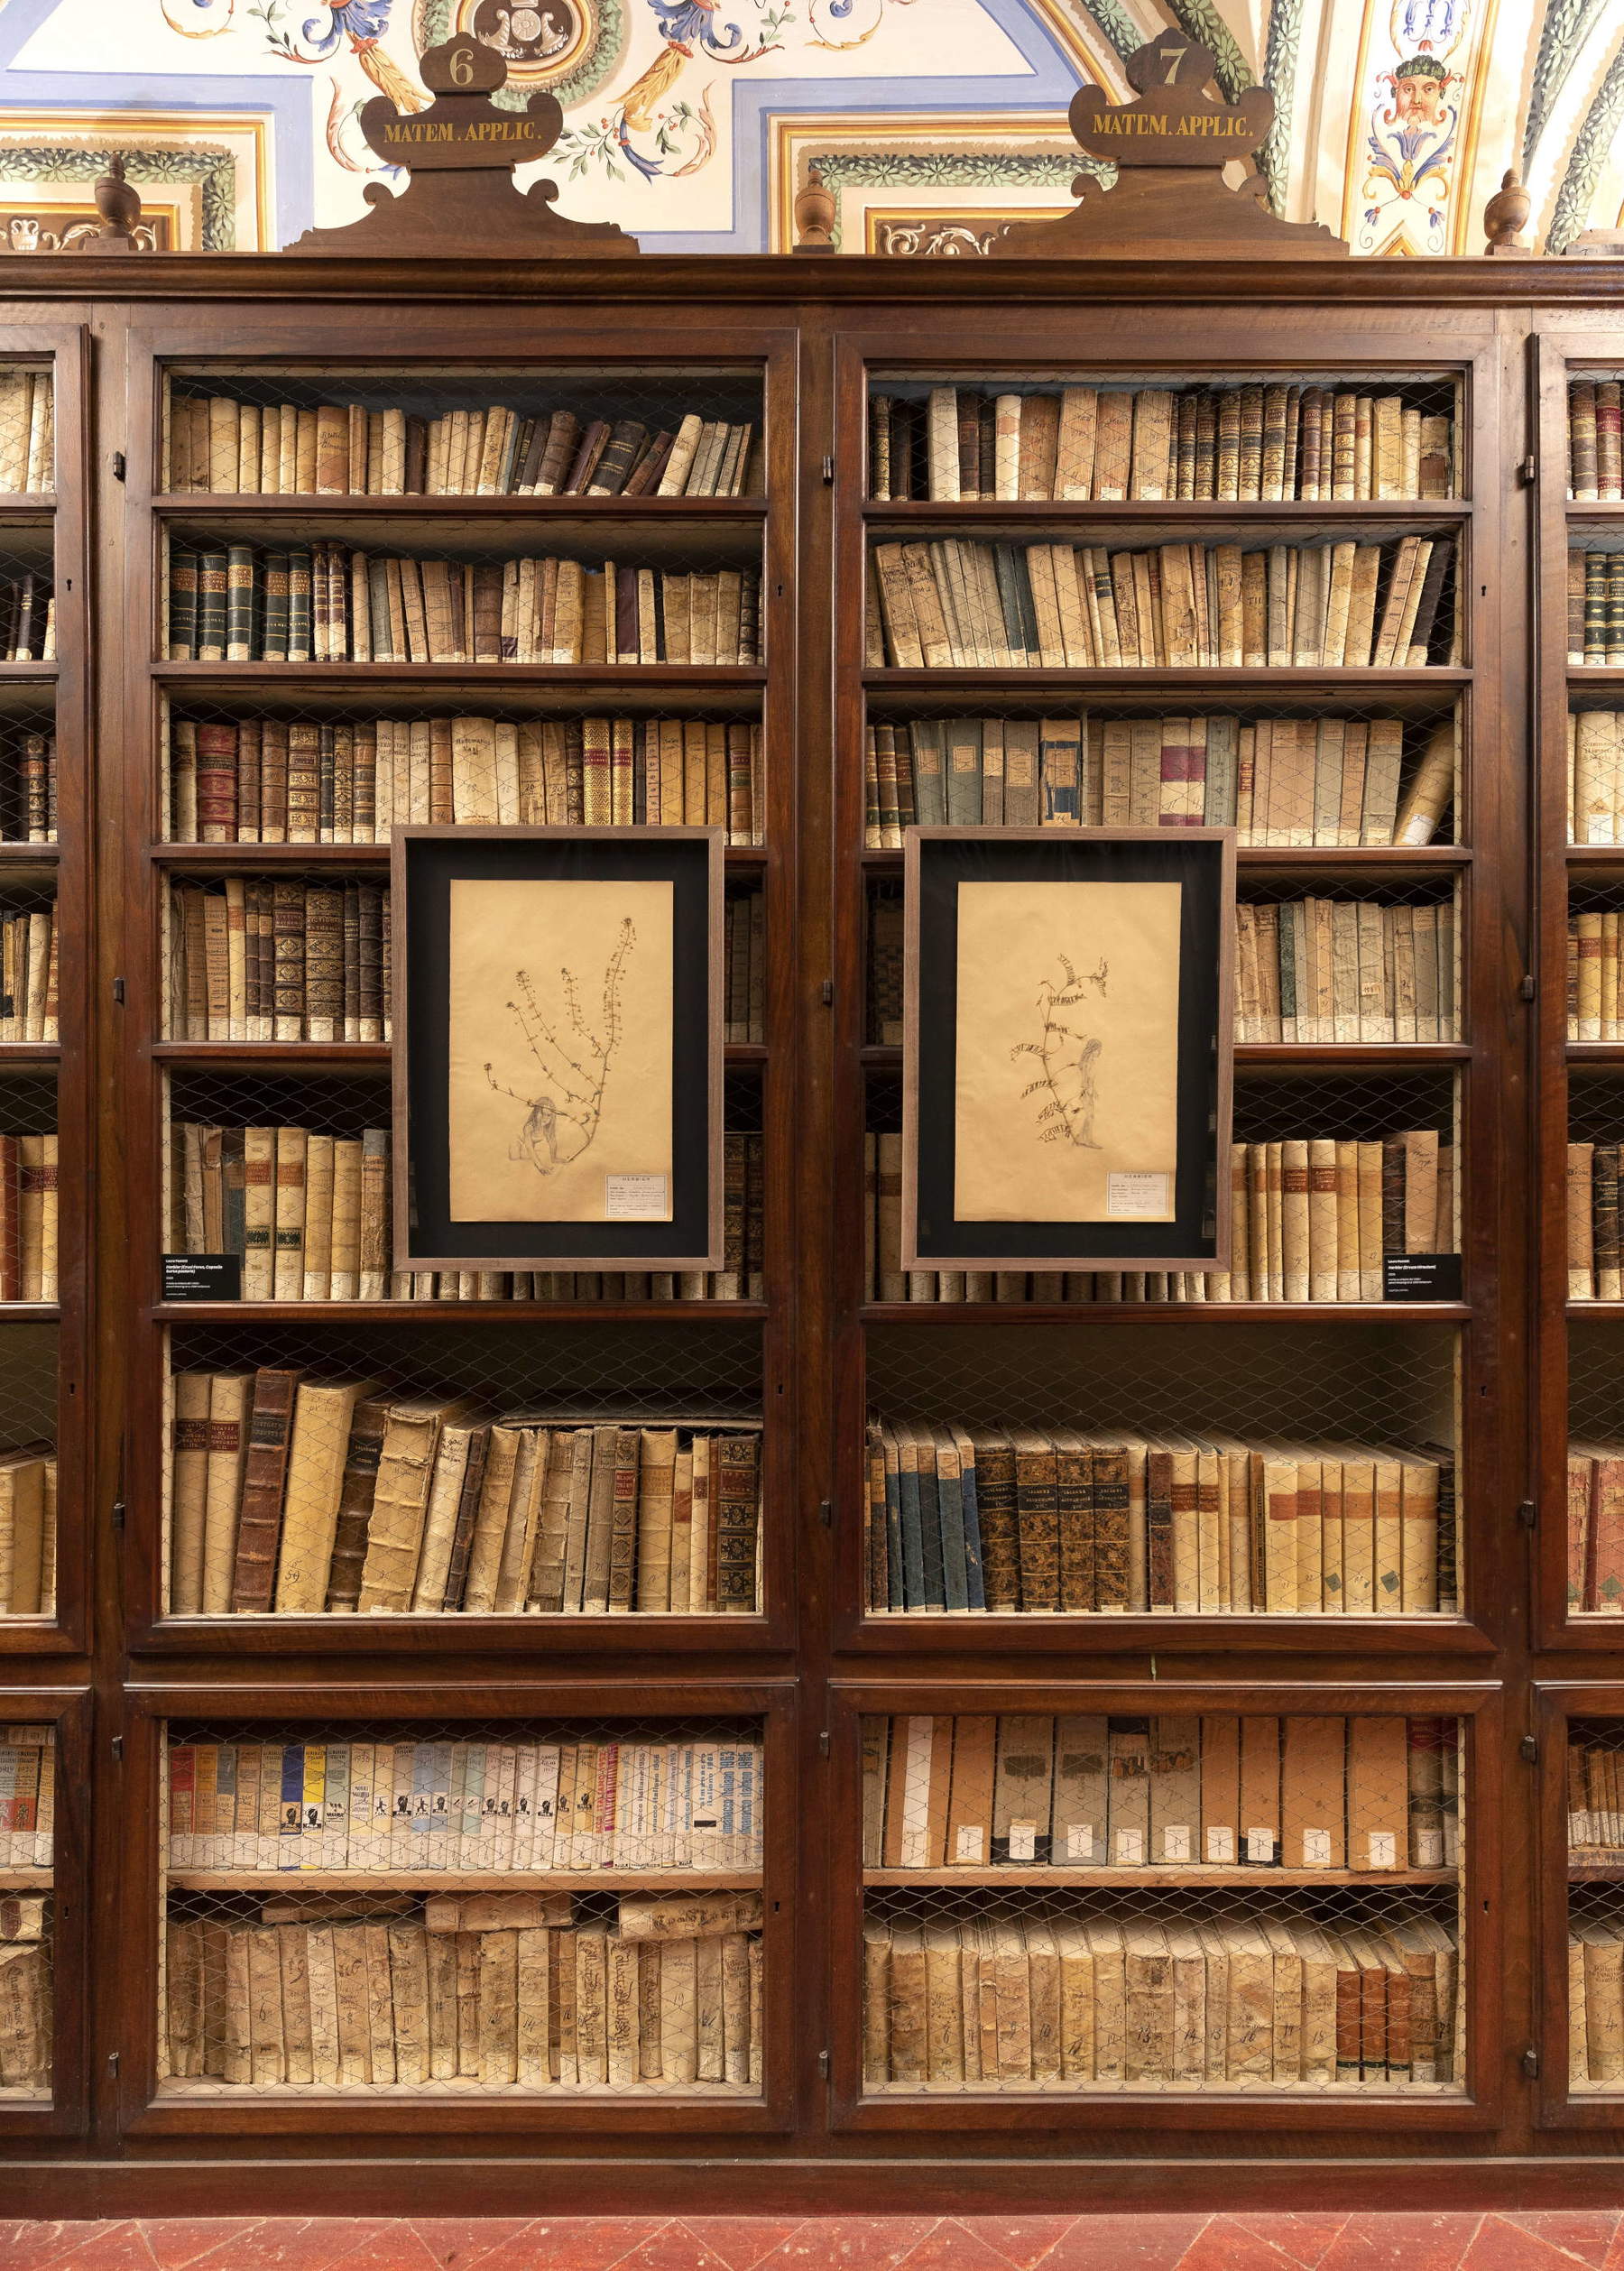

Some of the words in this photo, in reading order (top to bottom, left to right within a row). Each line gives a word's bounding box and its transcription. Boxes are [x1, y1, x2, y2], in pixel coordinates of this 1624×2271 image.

[449, 48, 474, 86] 6
[1160, 48, 1187, 86] 7
[466, 122, 541, 142] APPLIC.
[1176, 115, 1253, 136] APPLIC.
[721, 1771, 734, 1797] italiano
[740, 1772, 752, 1797] italiano
